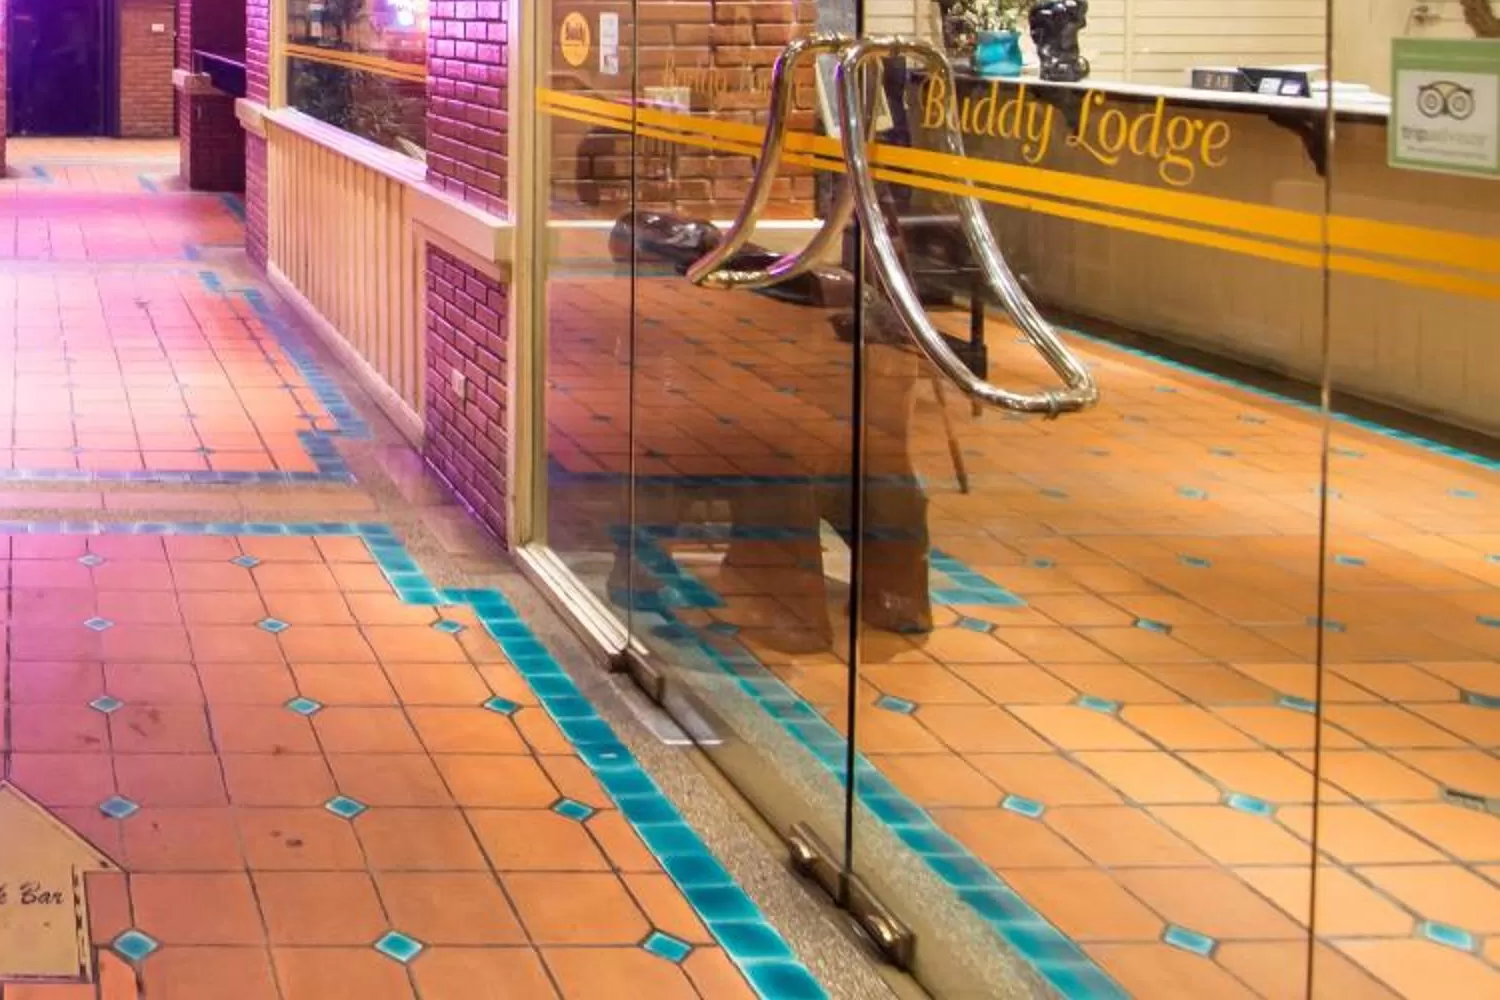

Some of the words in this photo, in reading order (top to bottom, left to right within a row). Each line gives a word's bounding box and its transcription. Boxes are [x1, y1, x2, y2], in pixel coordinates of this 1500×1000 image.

[920, 74, 1053, 164] Buddy
[1066, 88, 1230, 186] Lodge
[19, 880, 65, 906] Bar
